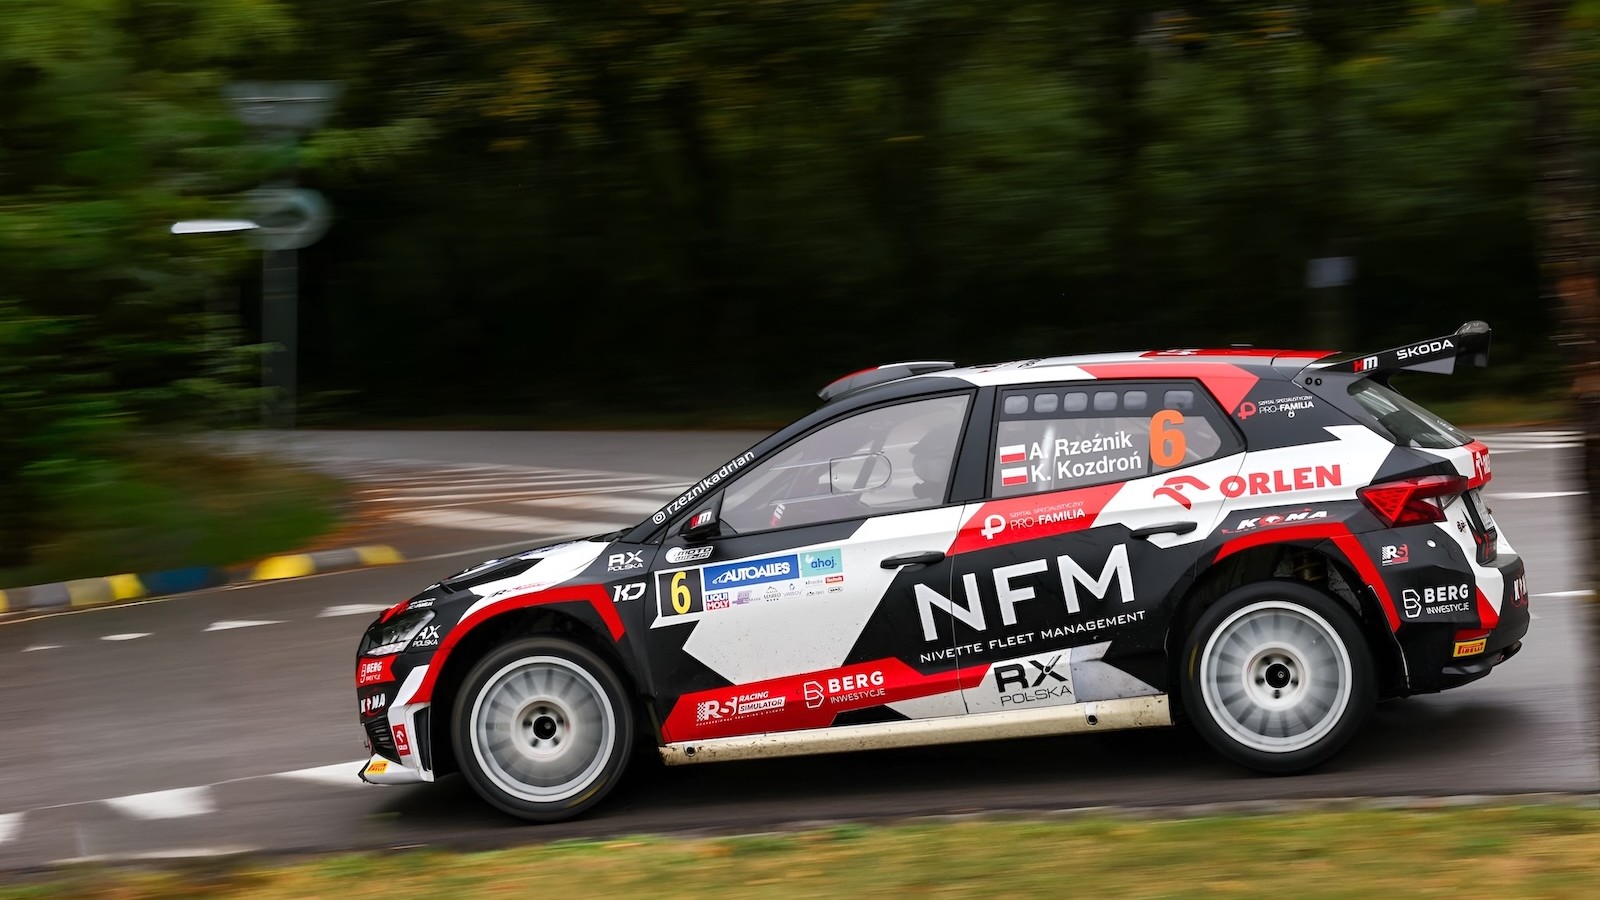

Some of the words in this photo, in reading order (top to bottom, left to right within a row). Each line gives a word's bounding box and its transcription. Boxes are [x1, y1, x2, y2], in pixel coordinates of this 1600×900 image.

[1396, 339, 1454, 360] SKODA
[1259, 401, 1314, 414] PRO-FAMILIA
[1029, 442, 1048, 461] A.
[1055, 431, 1133, 457] Rzeźnik
[1150, 409, 1186, 468] 6
[1031, 465, 1051, 483] K.
[1058, 452, 1142, 480] Kozdroń
[666, 451, 755, 515] rzeznikadrian
[1219, 464, 1342, 498] ORLEN
[1010, 508, 1086, 530] PRO-FAMILIA
[607, 563, 643, 572] POLSKA
[608, 550, 643, 566] RX
[723, 562, 790, 583] AUTOALLES
[670, 571, 691, 615] 6
[706, 592, 728, 601] LIQUI
[913, 543, 1135, 641] NFM
[1424, 584, 1469, 603] BERG
[707, 600, 730, 610] MOLY
[1426, 602, 1470, 614] INWESTYCJE
[412, 639, 438, 647] POLSKA
[920, 643, 983, 663] NIVETTE
[989, 632, 1034, 650] FLEET
[1041, 610, 1146, 638] MANAGEMENT
[366, 661, 382, 674] BERG
[993, 655, 1069, 692] RX
[828, 671, 884, 693] BERG
[739, 691, 769, 703] RACING
[740, 698, 783, 712] SIMULATOR
[830, 688, 886, 704] INWESTYCJE
[1000, 685, 1073, 706] POLSKA
